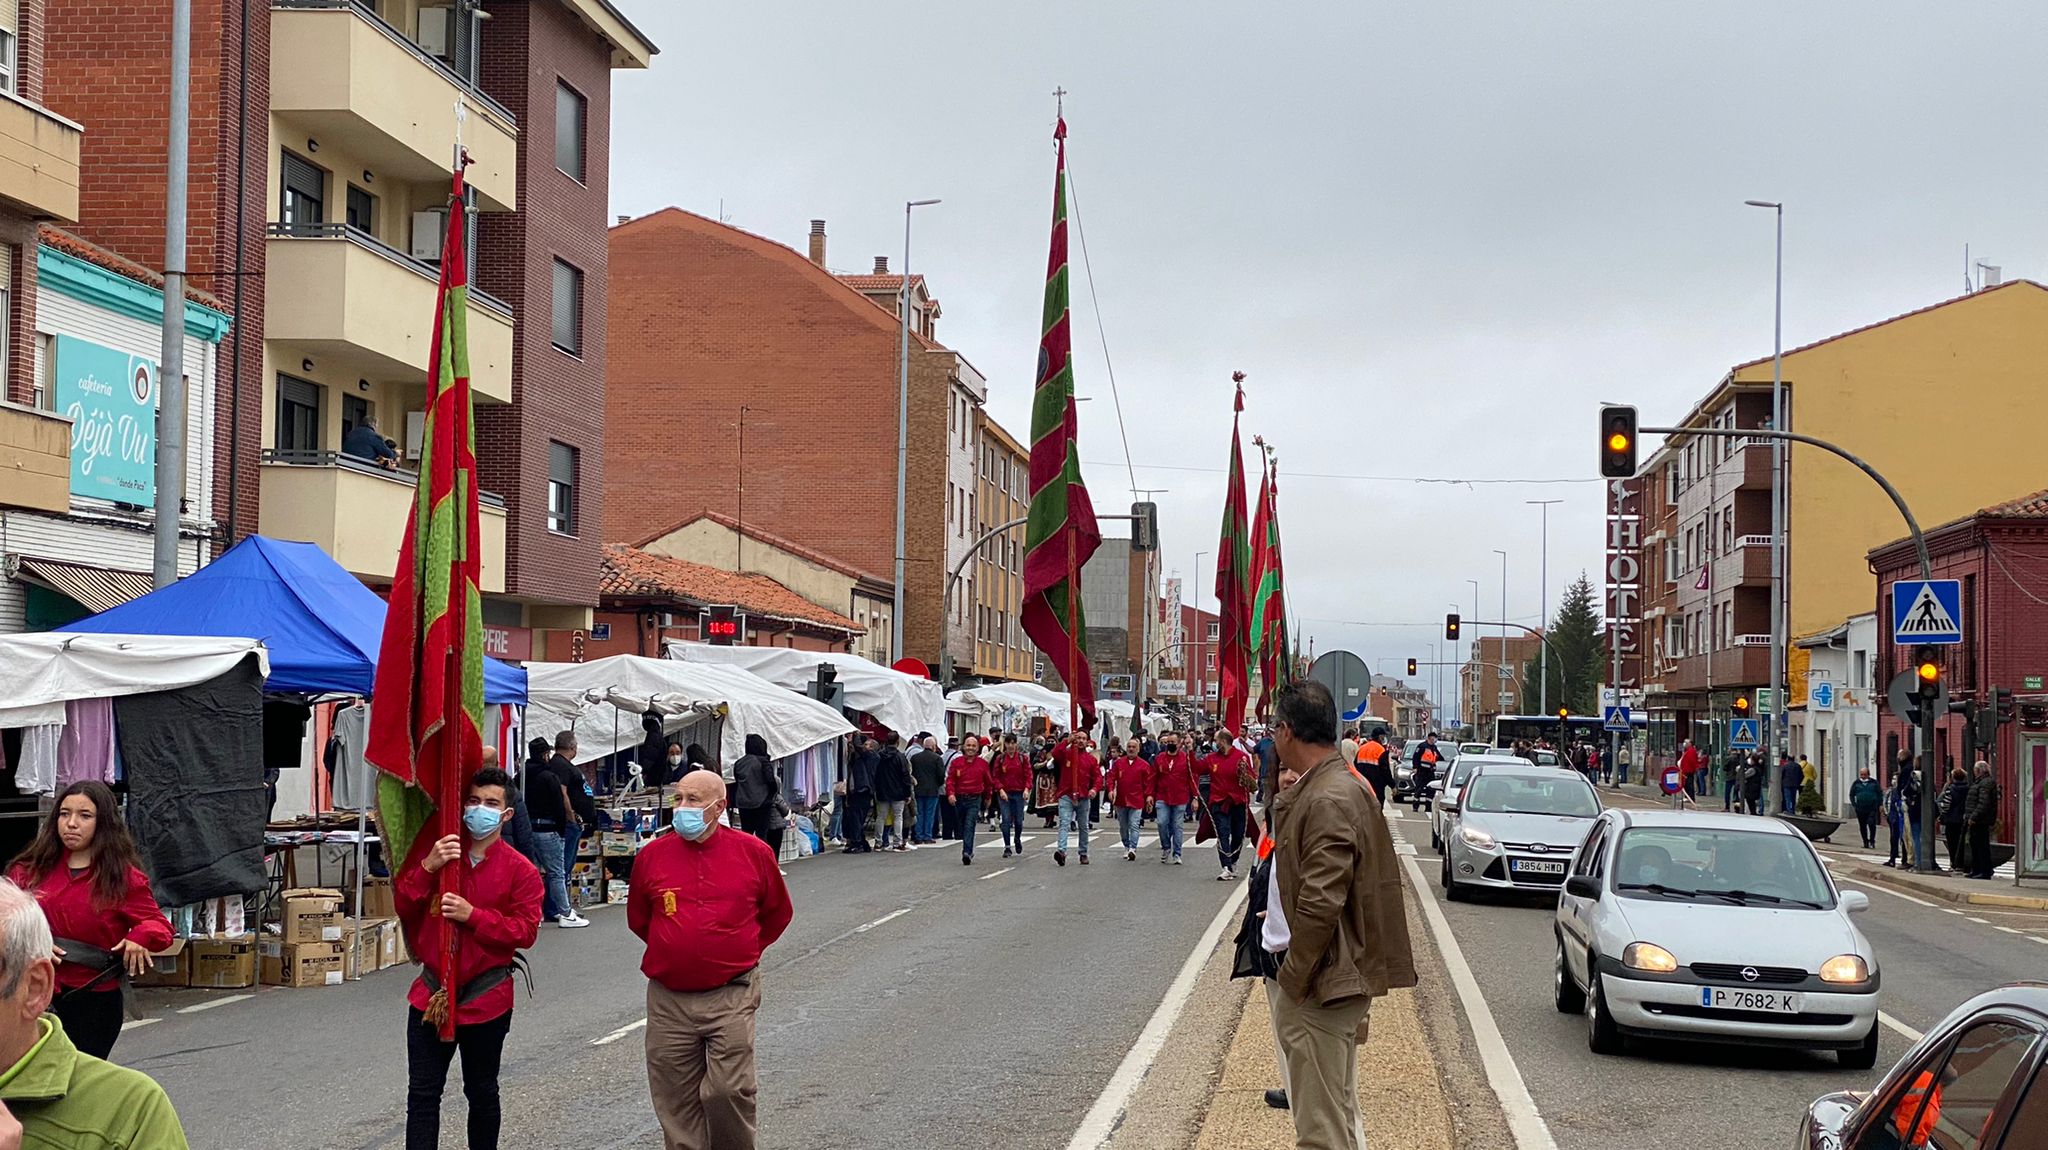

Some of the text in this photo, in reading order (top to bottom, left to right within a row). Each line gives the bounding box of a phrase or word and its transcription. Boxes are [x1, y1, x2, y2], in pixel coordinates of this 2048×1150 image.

[118, 414, 148, 465] Vu
[1609, 521, 1640, 687] HOTEL
[709, 622, 736, 634] 11:03
[482, 628, 509, 654] PFRE
[1518, 861, 1542, 871] 3854
[1716, 990, 1793, 1011] P 7682 K
